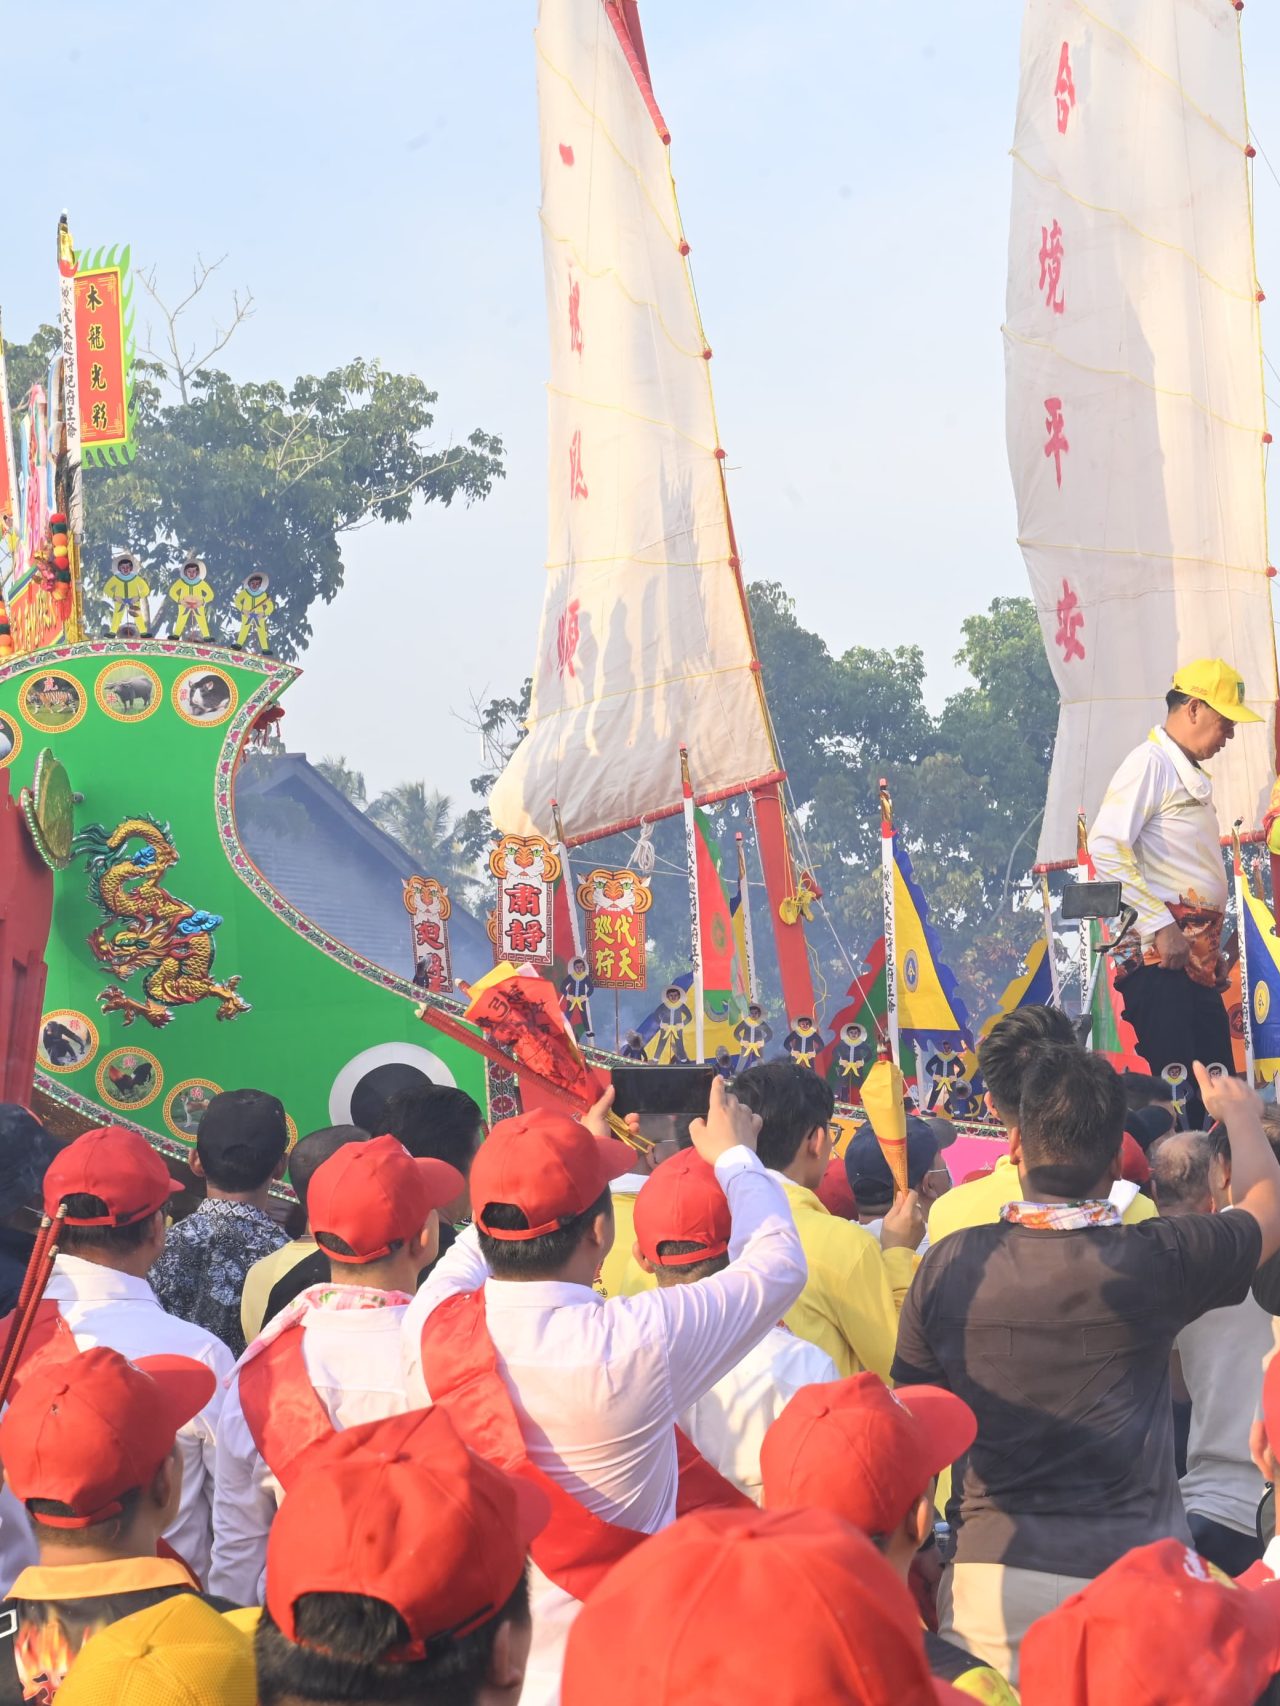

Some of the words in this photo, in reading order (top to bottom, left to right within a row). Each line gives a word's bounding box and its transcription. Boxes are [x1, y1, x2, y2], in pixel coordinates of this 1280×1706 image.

[86, 284, 108, 430] 木龍光彩
[504, 883, 545, 952] 肅靜
[614, 914, 638, 980] 代天
